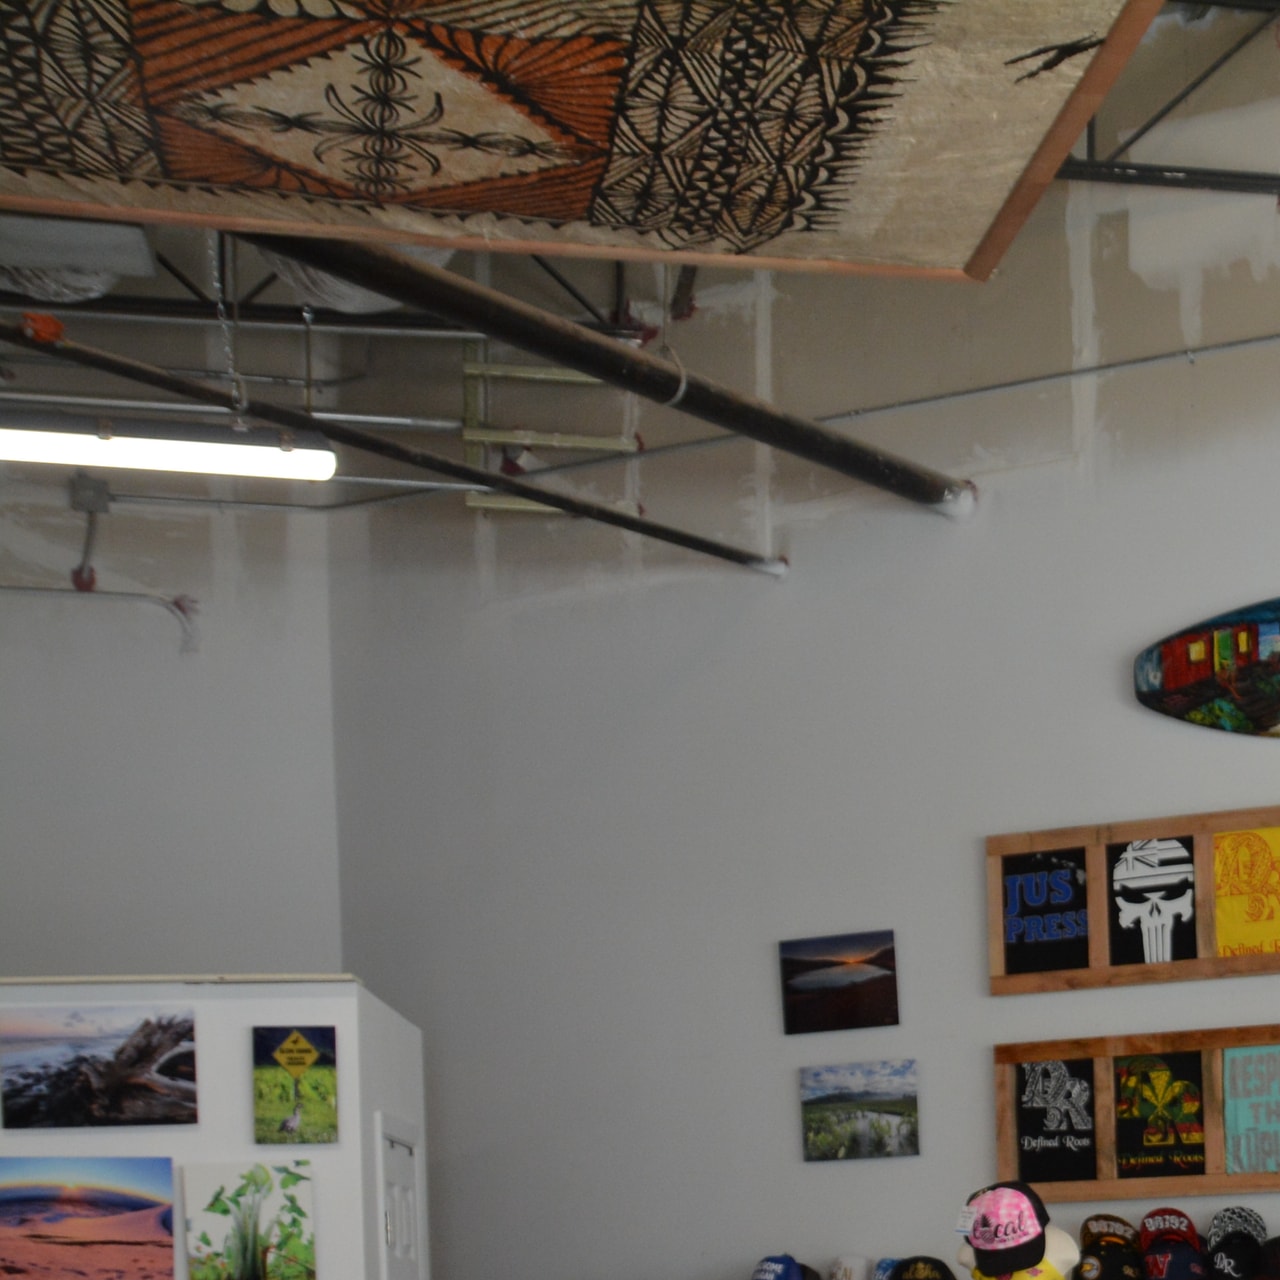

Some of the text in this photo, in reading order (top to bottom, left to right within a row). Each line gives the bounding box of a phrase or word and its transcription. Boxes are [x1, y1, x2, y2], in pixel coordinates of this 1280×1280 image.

[1005, 869, 1073, 915] JUS
[1021, 1135, 1091, 1151] Defined Roots
